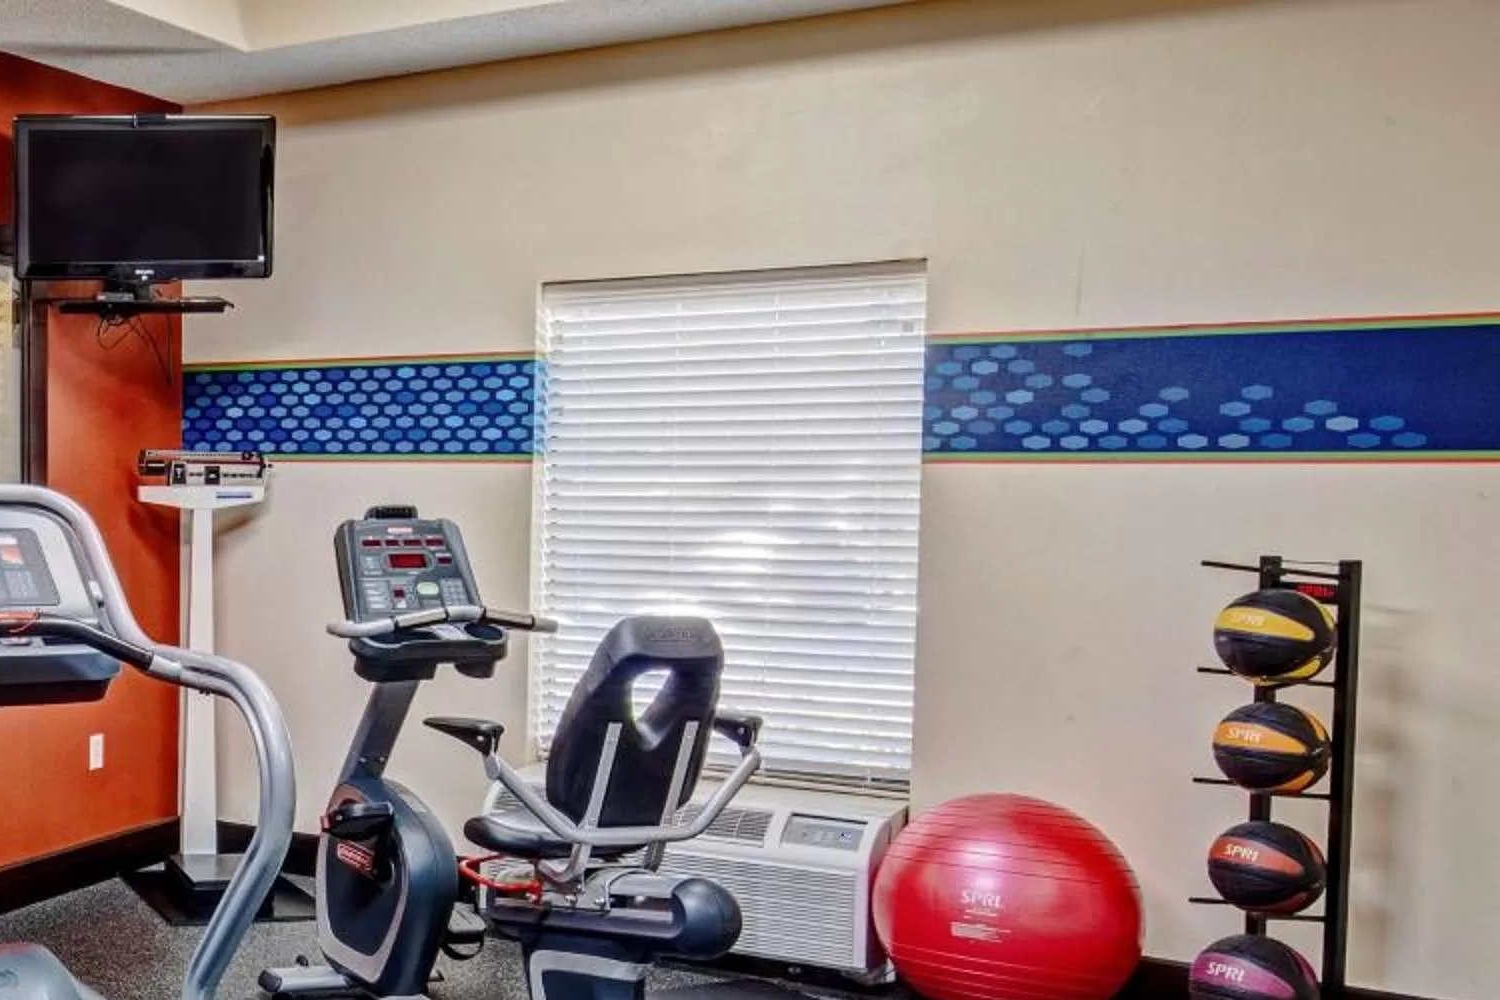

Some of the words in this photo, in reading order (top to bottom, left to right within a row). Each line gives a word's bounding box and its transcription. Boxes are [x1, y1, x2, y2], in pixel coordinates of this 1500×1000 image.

[1226, 726, 1261, 743] SPRI
[1223, 843, 1260, 862] SPRI
[961, 888, 1001, 909] SPRI
[1206, 961, 1246, 982] SPRI
